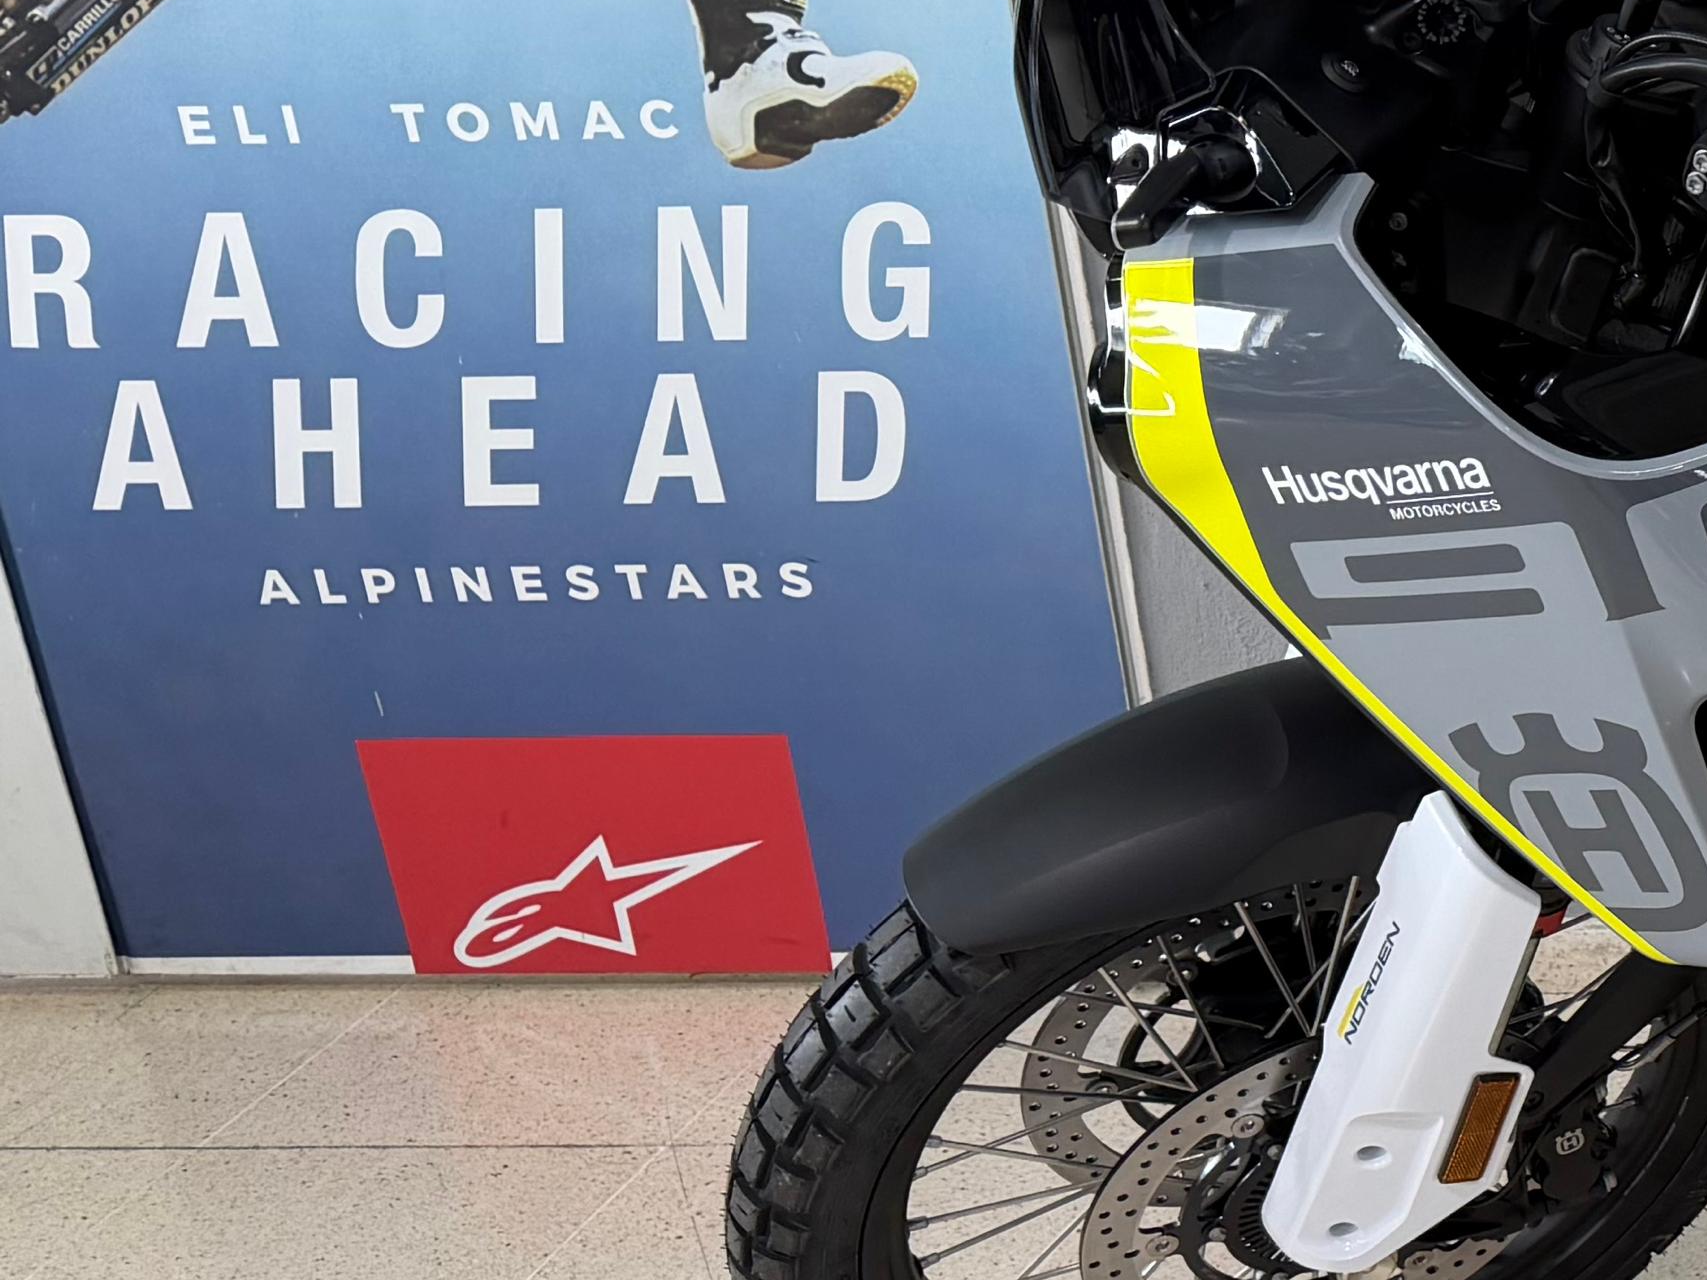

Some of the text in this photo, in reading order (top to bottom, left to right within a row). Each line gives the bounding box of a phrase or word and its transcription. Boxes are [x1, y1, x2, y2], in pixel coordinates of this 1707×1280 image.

[176, 98, 679, 147] ELI TOMAC
[3, 201, 932, 349] RACING
[93, 371, 906, 510] AHEAD
[1262, 456, 1492, 506] Husqvarna
[1389, 498, 1502, 521] MOTORCYCLES
[259, 561, 815, 606] ALPINESTARS
[1344, 920, 1401, 1045] NORDEN
